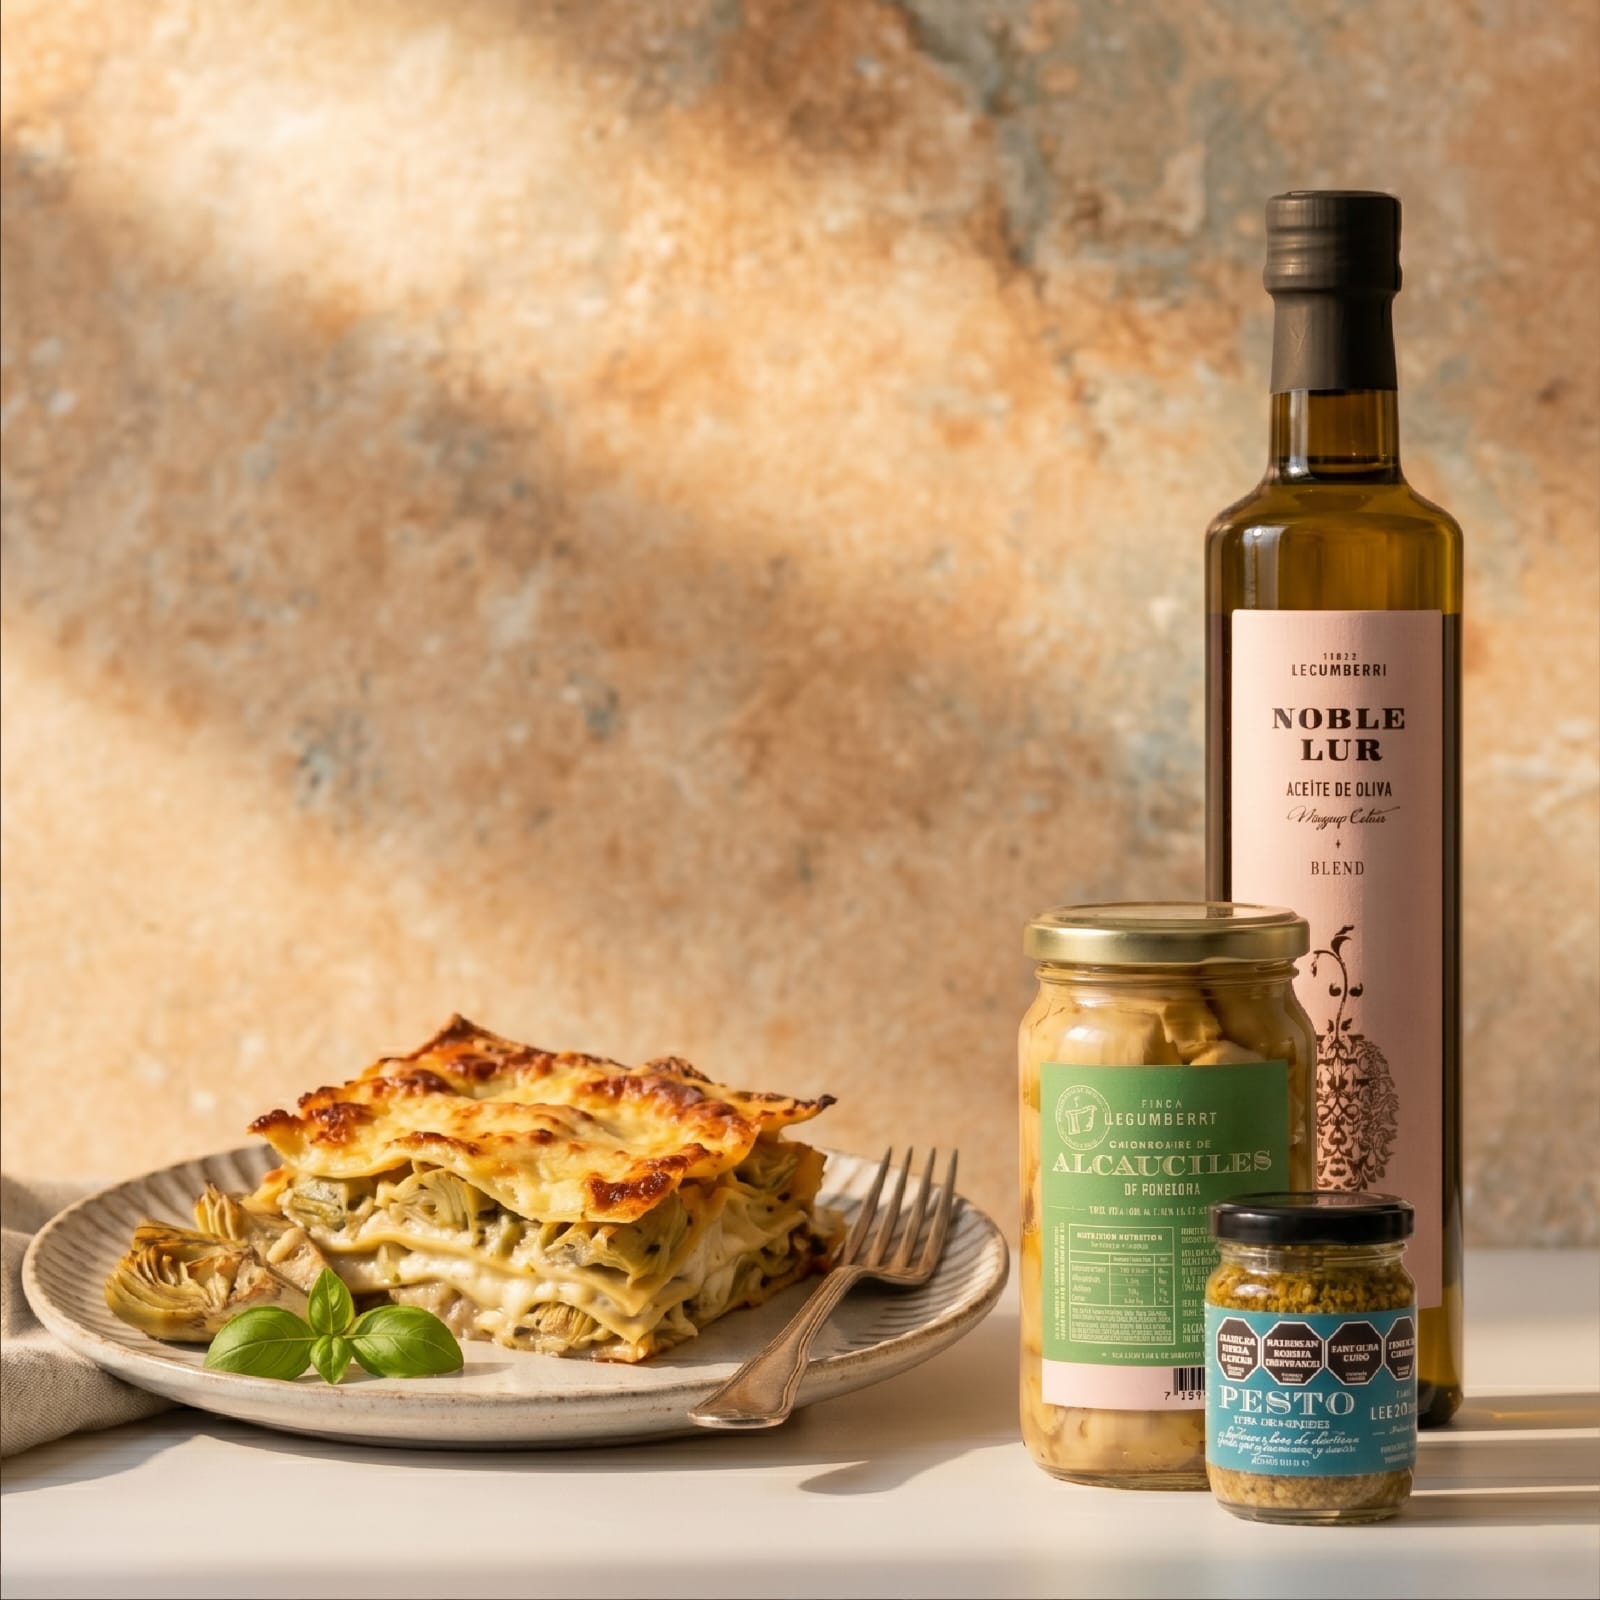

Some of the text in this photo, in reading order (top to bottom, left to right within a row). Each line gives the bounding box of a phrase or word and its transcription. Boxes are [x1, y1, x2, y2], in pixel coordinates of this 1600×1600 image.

[1291, 663, 1387, 677] LECUMBERRI
[1272, 707, 1406, 730] NOBLE
[1300, 738, 1383, 761] LUR
[1335, 781, 1351, 797] DE
[1356, 781, 1392, 797] OLIVA
[1311, 861, 1365, 875] BLEND
[1142, 1099, 1182, 1109] FINCA
[1197, 1140, 1212, 1149] DE
[1052, 1150, 1272, 1177] ALCAUCILES
[1164, 1391, 1171, 1400] 7
[1218, 1384, 1355, 1415] PESTO
